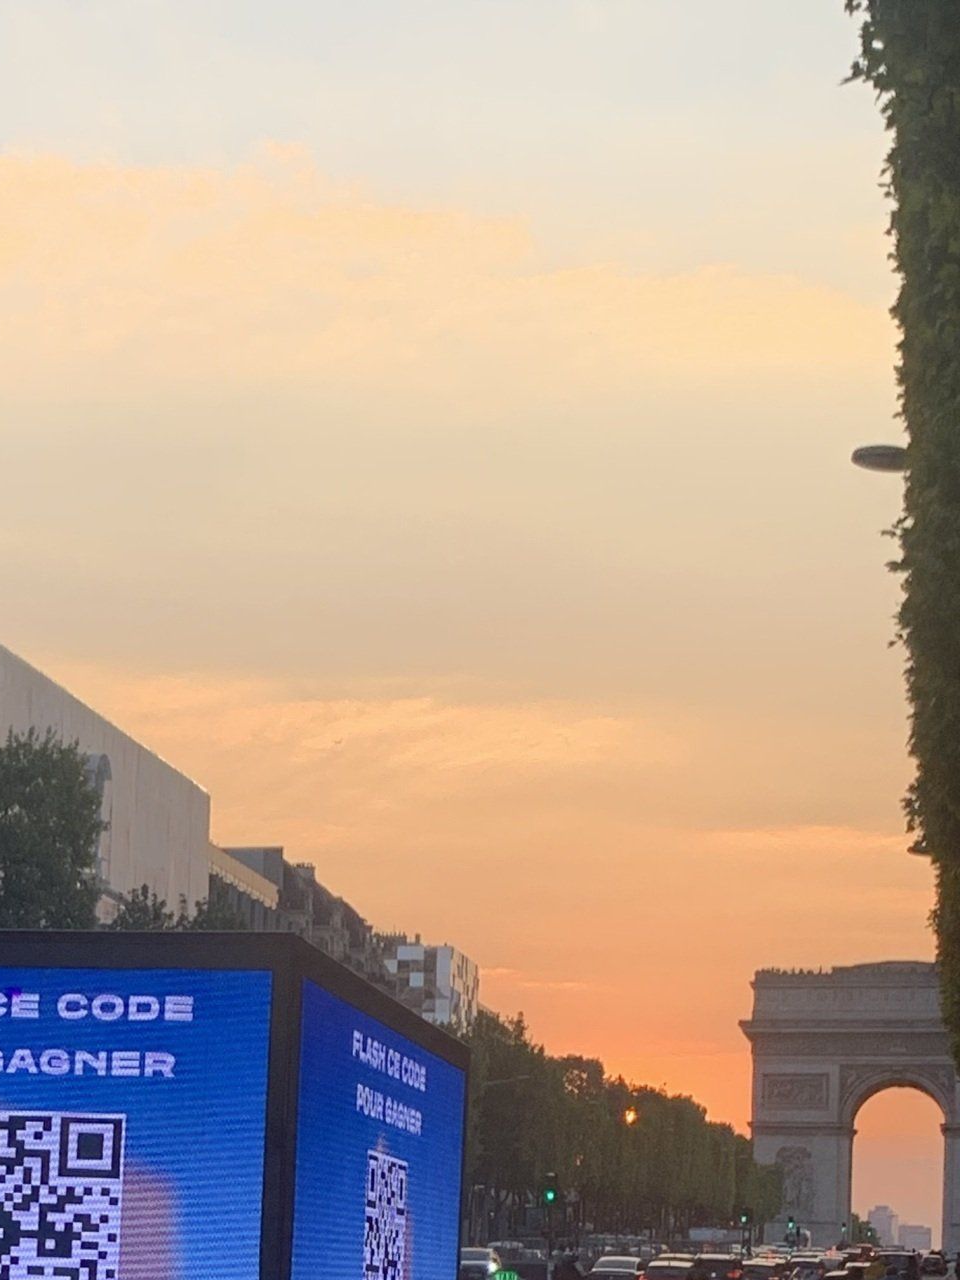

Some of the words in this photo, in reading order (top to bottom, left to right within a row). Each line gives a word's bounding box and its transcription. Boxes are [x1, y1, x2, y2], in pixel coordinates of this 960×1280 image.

[57, 993, 194, 1022] CODE
[352, 1029, 387, 1074] FLASH
[387, 1048, 401, 1080] CE
[401, 1056, 427, 1092] CODE
[356, 1083, 384, 1120] POUR
[385, 1096, 422, 1136] GAGNER
